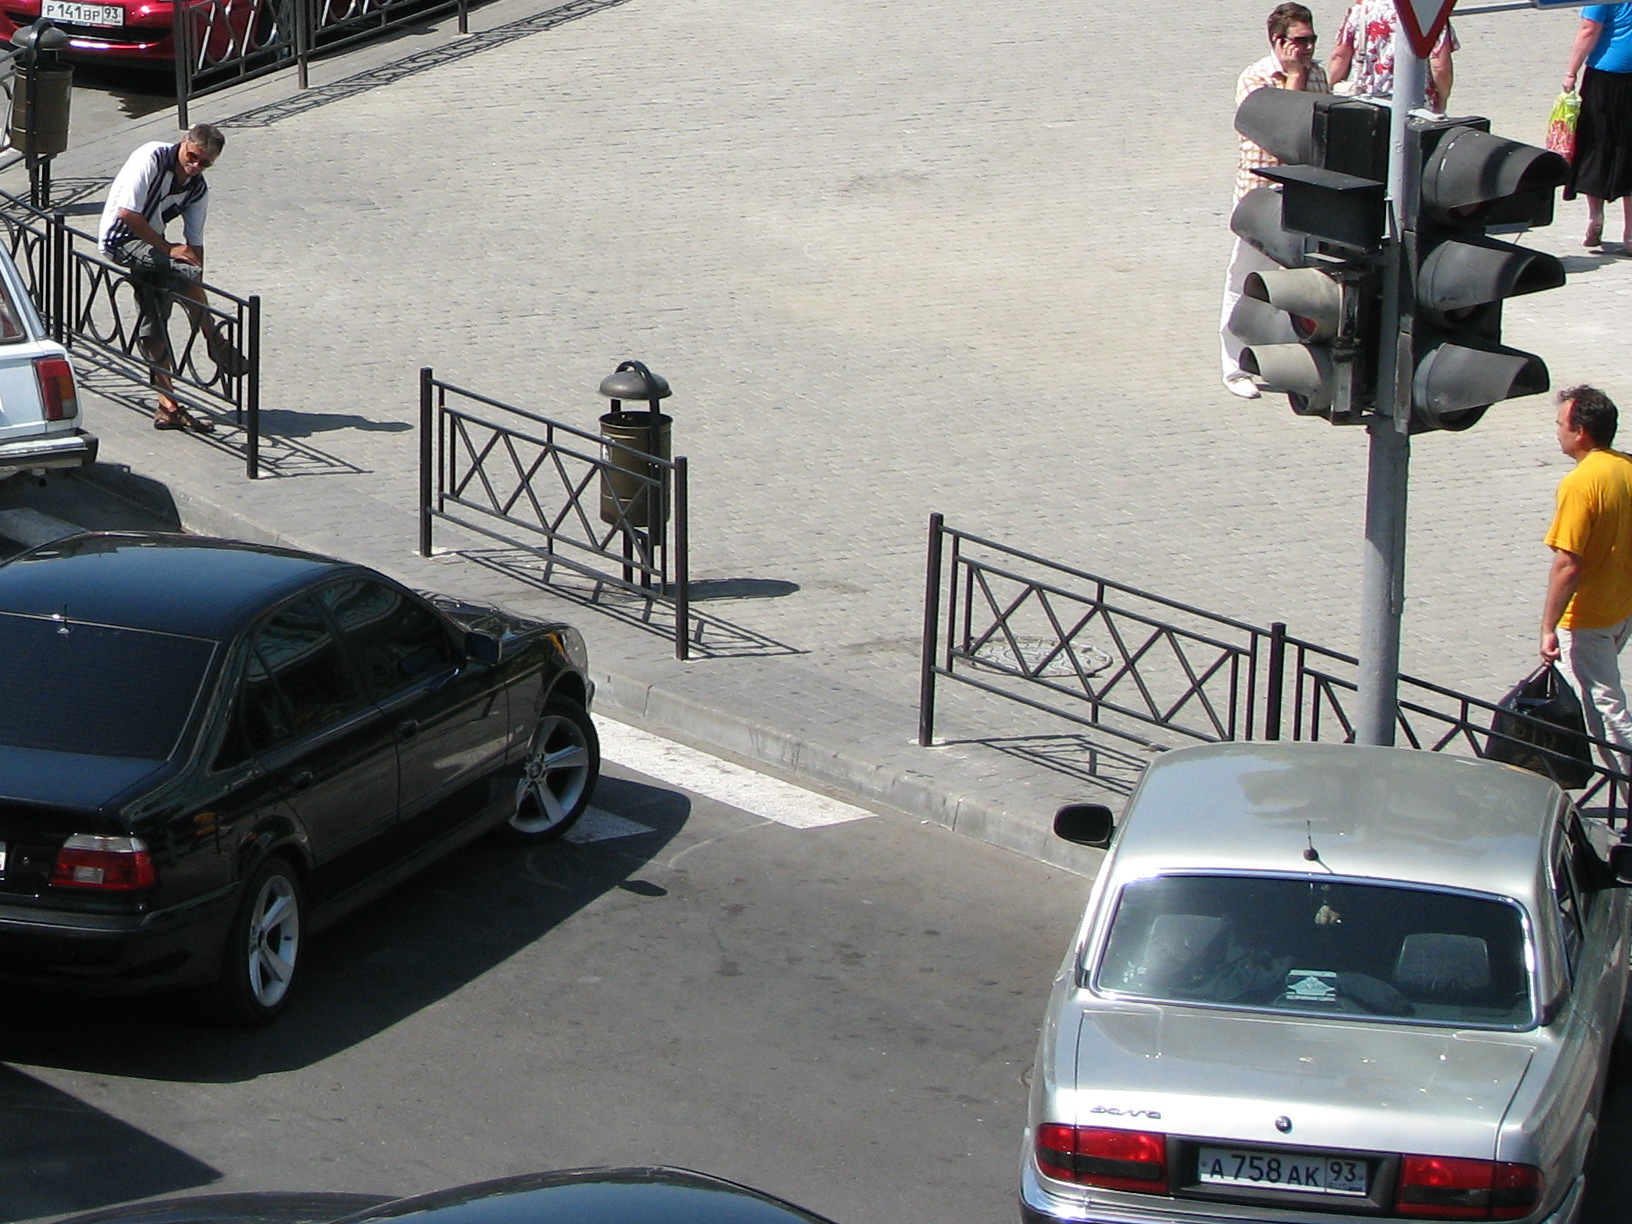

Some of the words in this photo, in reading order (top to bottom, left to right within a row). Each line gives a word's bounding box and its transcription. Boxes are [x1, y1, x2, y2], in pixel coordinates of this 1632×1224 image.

[104, 7, 118, 19] 93
[1209, 1154, 1319, 1187] А758АК
[1330, 1161, 1357, 1182] 93
